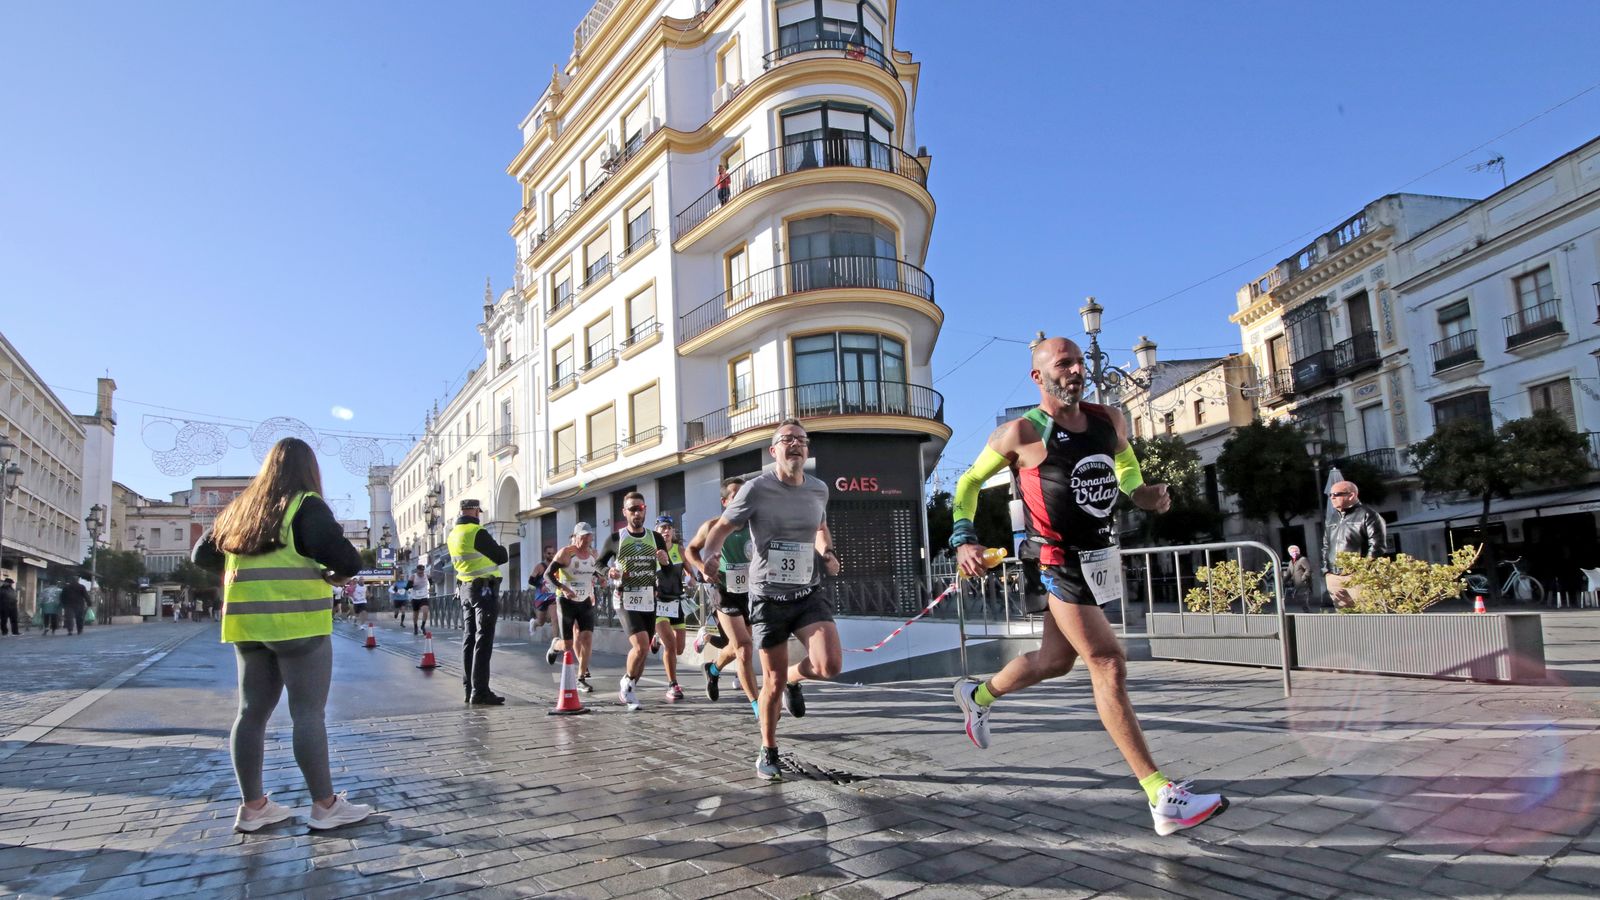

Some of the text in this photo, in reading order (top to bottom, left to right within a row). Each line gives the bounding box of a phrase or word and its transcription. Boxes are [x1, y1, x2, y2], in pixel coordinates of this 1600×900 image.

[835, 477, 879, 491] GAES
[1070, 472, 1116, 488] Donando
[1073, 485, 1117, 504] Vidas
[381, 548, 391, 558] P
[781, 558, 795, 571] 33
[735, 575, 746, 584] 80
[1090, 569, 1108, 587] 107
[629, 596, 643, 605] 267
